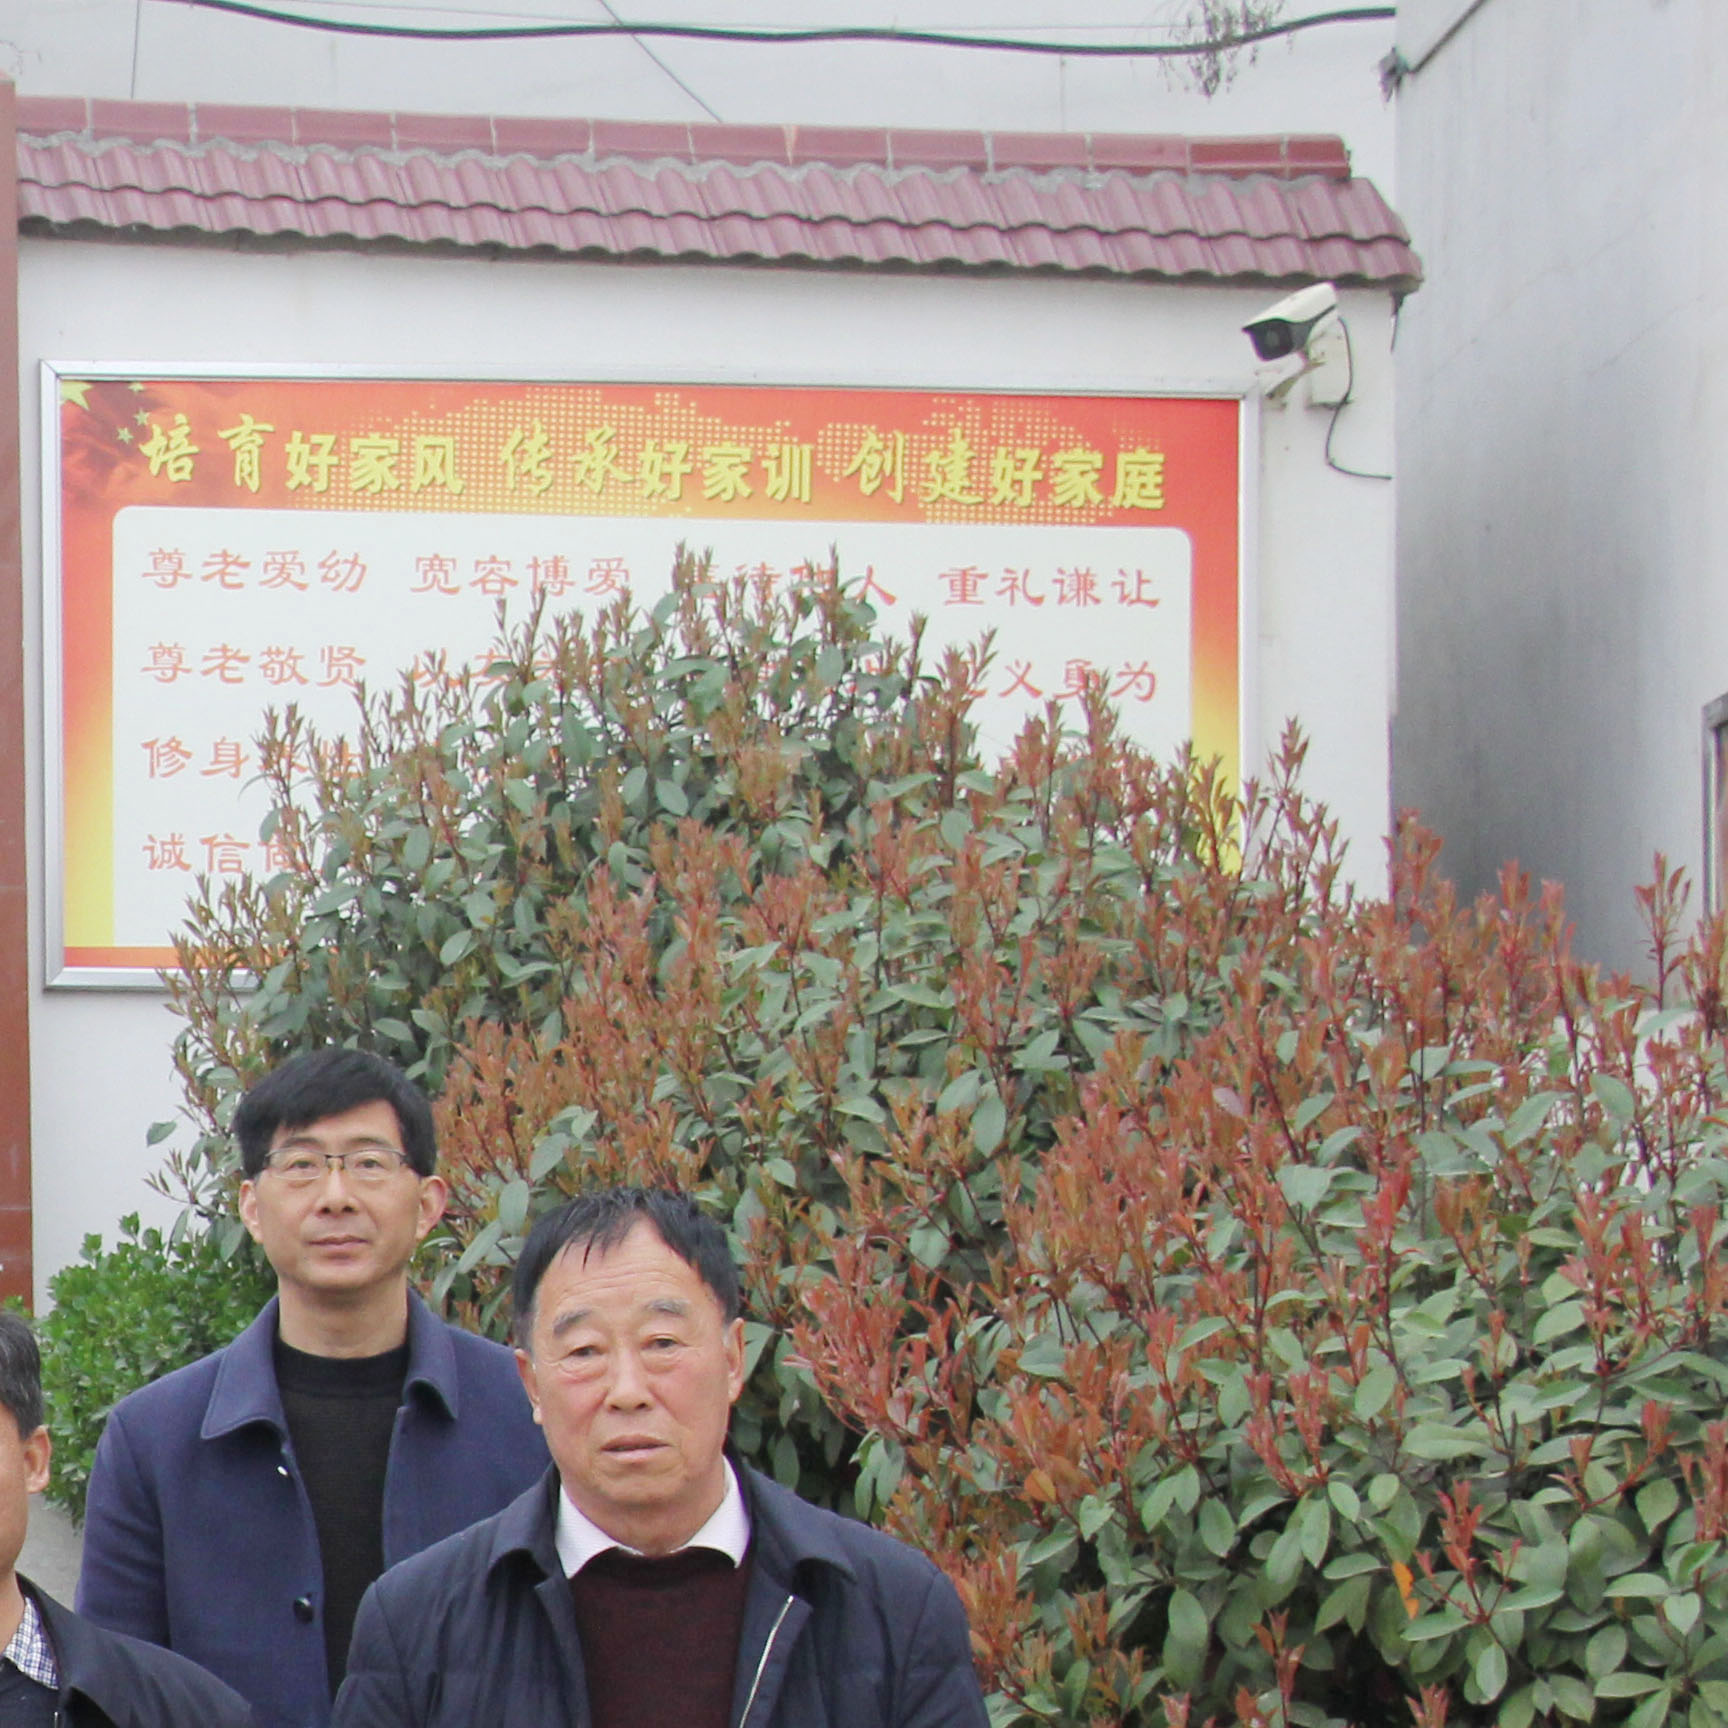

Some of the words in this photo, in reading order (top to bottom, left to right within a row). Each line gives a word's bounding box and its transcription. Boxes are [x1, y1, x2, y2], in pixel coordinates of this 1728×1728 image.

[137, 413, 466, 495] 培育好家风
[499, 420, 815, 502] 传承好家训
[843, 427, 1166, 509] 创建好家庭
[141, 547, 368, 592] 尊老爱幼
[410, 553, 633, 597] 宽容博爱
[938, 565, 1160, 608] 重礼谦让
[140, 641, 367, 688] 尊老敬贤
